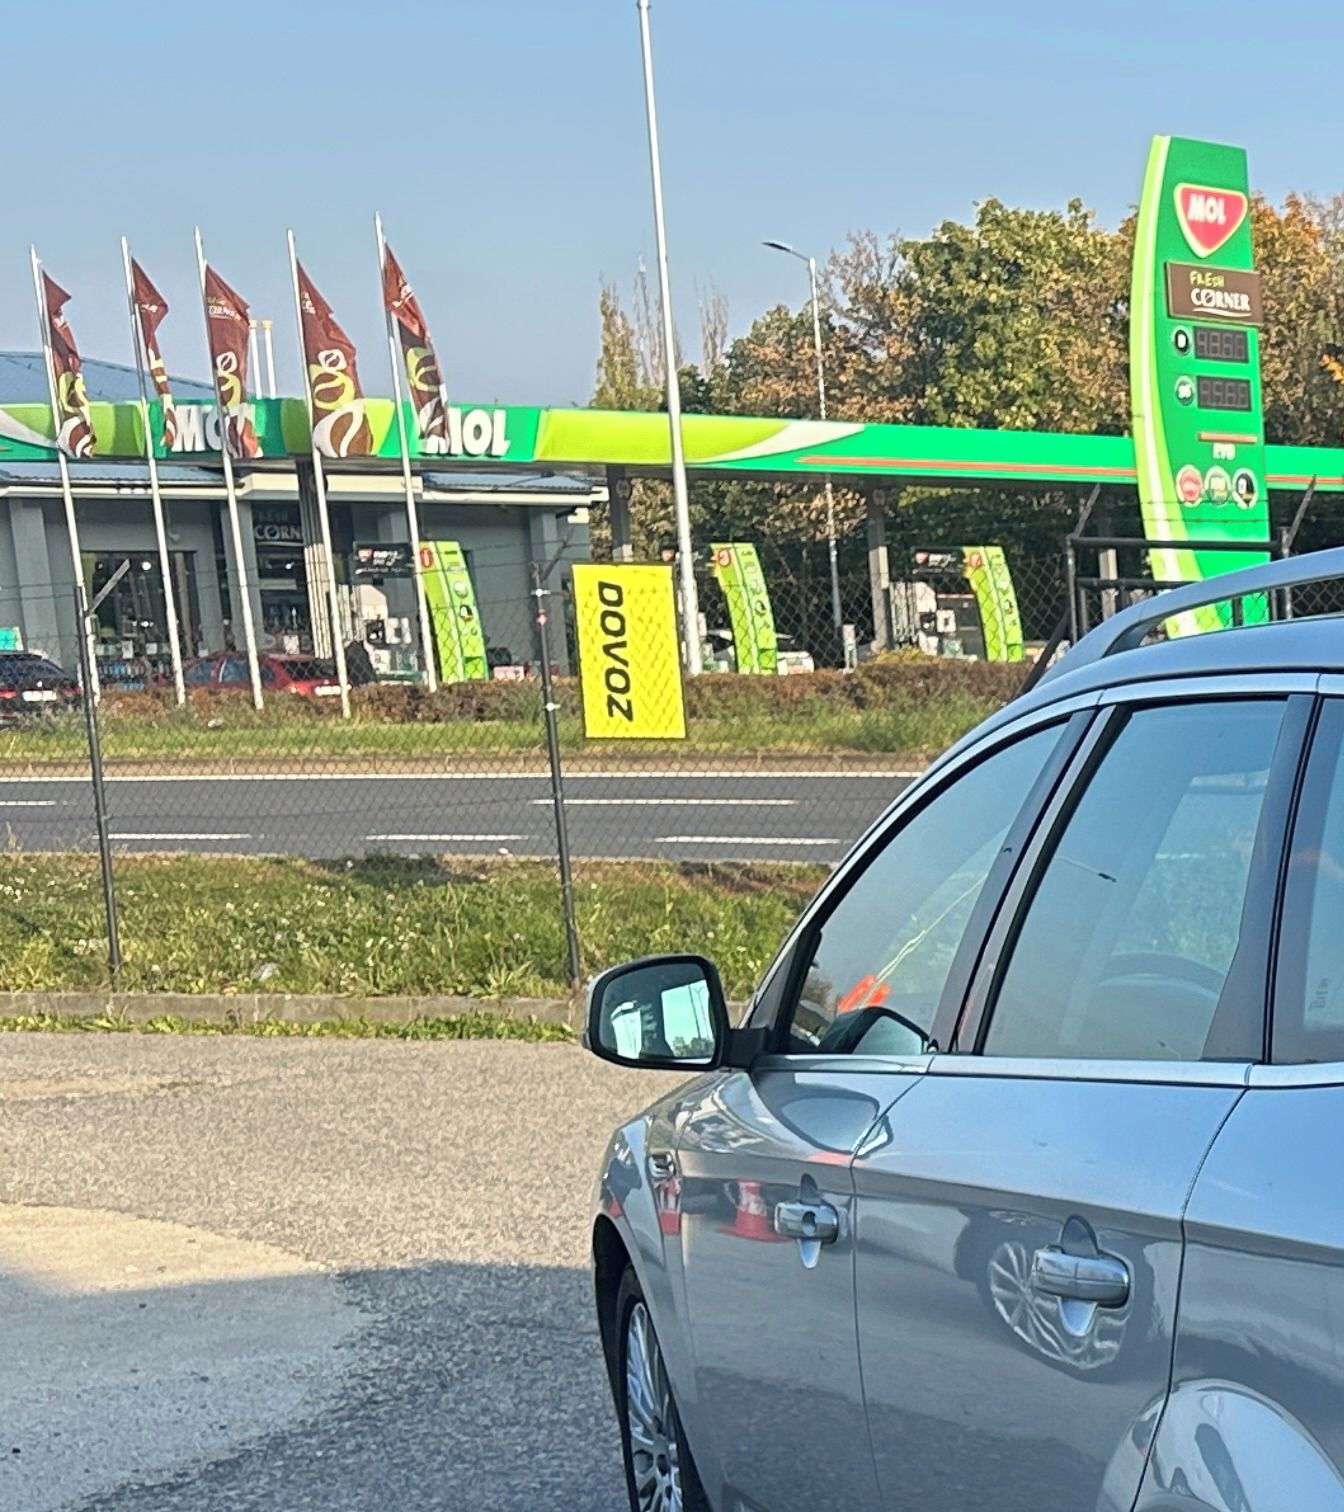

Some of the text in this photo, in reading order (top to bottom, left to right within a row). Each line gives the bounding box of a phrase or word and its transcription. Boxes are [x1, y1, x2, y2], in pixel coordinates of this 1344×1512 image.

[1187, 193, 1227, 225] MOL
[1189, 270, 1225, 288] FRESH
[1190, 287, 1251, 311] CORNER
[171, 404, 257, 452] MO
[255, 524, 302, 540] CORN
[598, 581, 634, 722] DOVOZ
